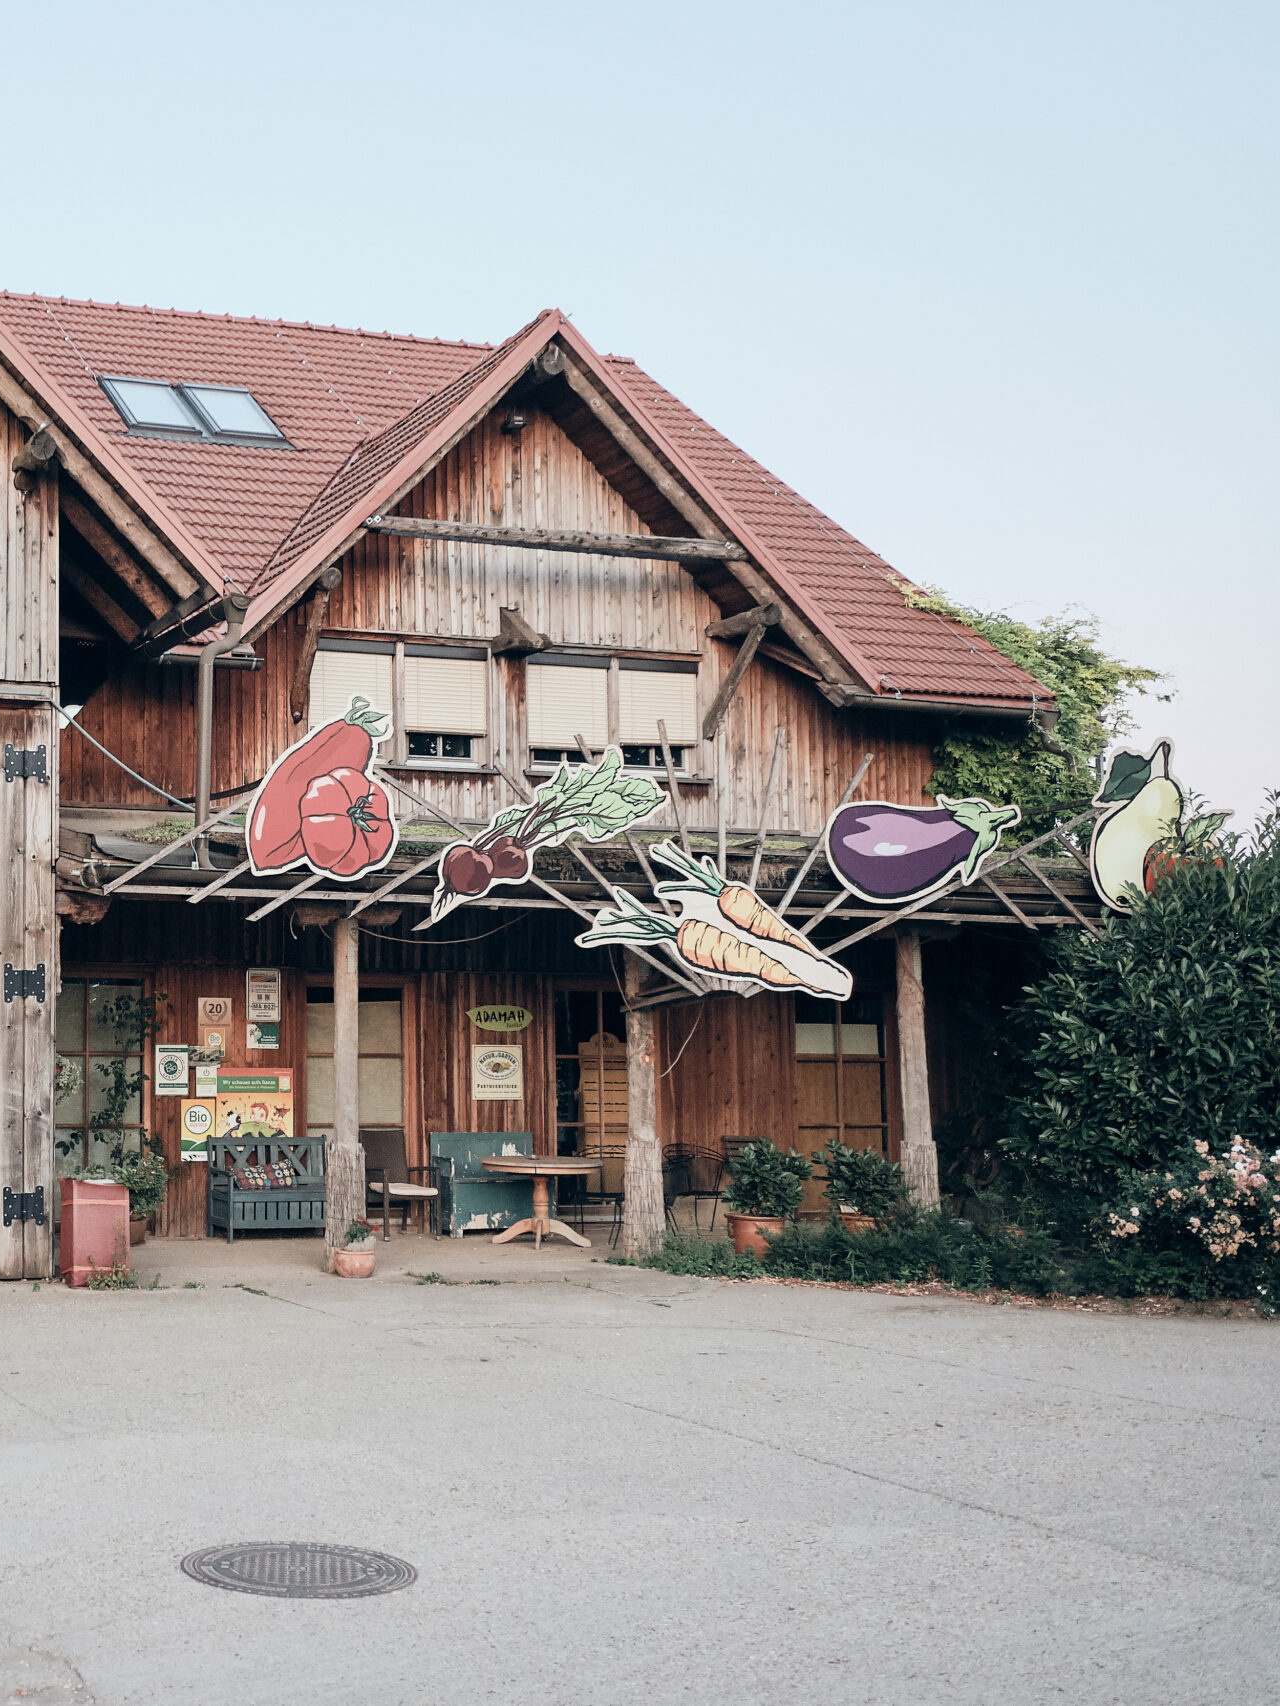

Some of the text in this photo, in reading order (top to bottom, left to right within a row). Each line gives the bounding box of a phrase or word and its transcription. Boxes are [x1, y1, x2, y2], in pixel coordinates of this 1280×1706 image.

[208, 1003, 222, 1014] 20
[475, 1010, 525, 1023] ADAMAH
[190, 1111, 207, 1122] Bio
